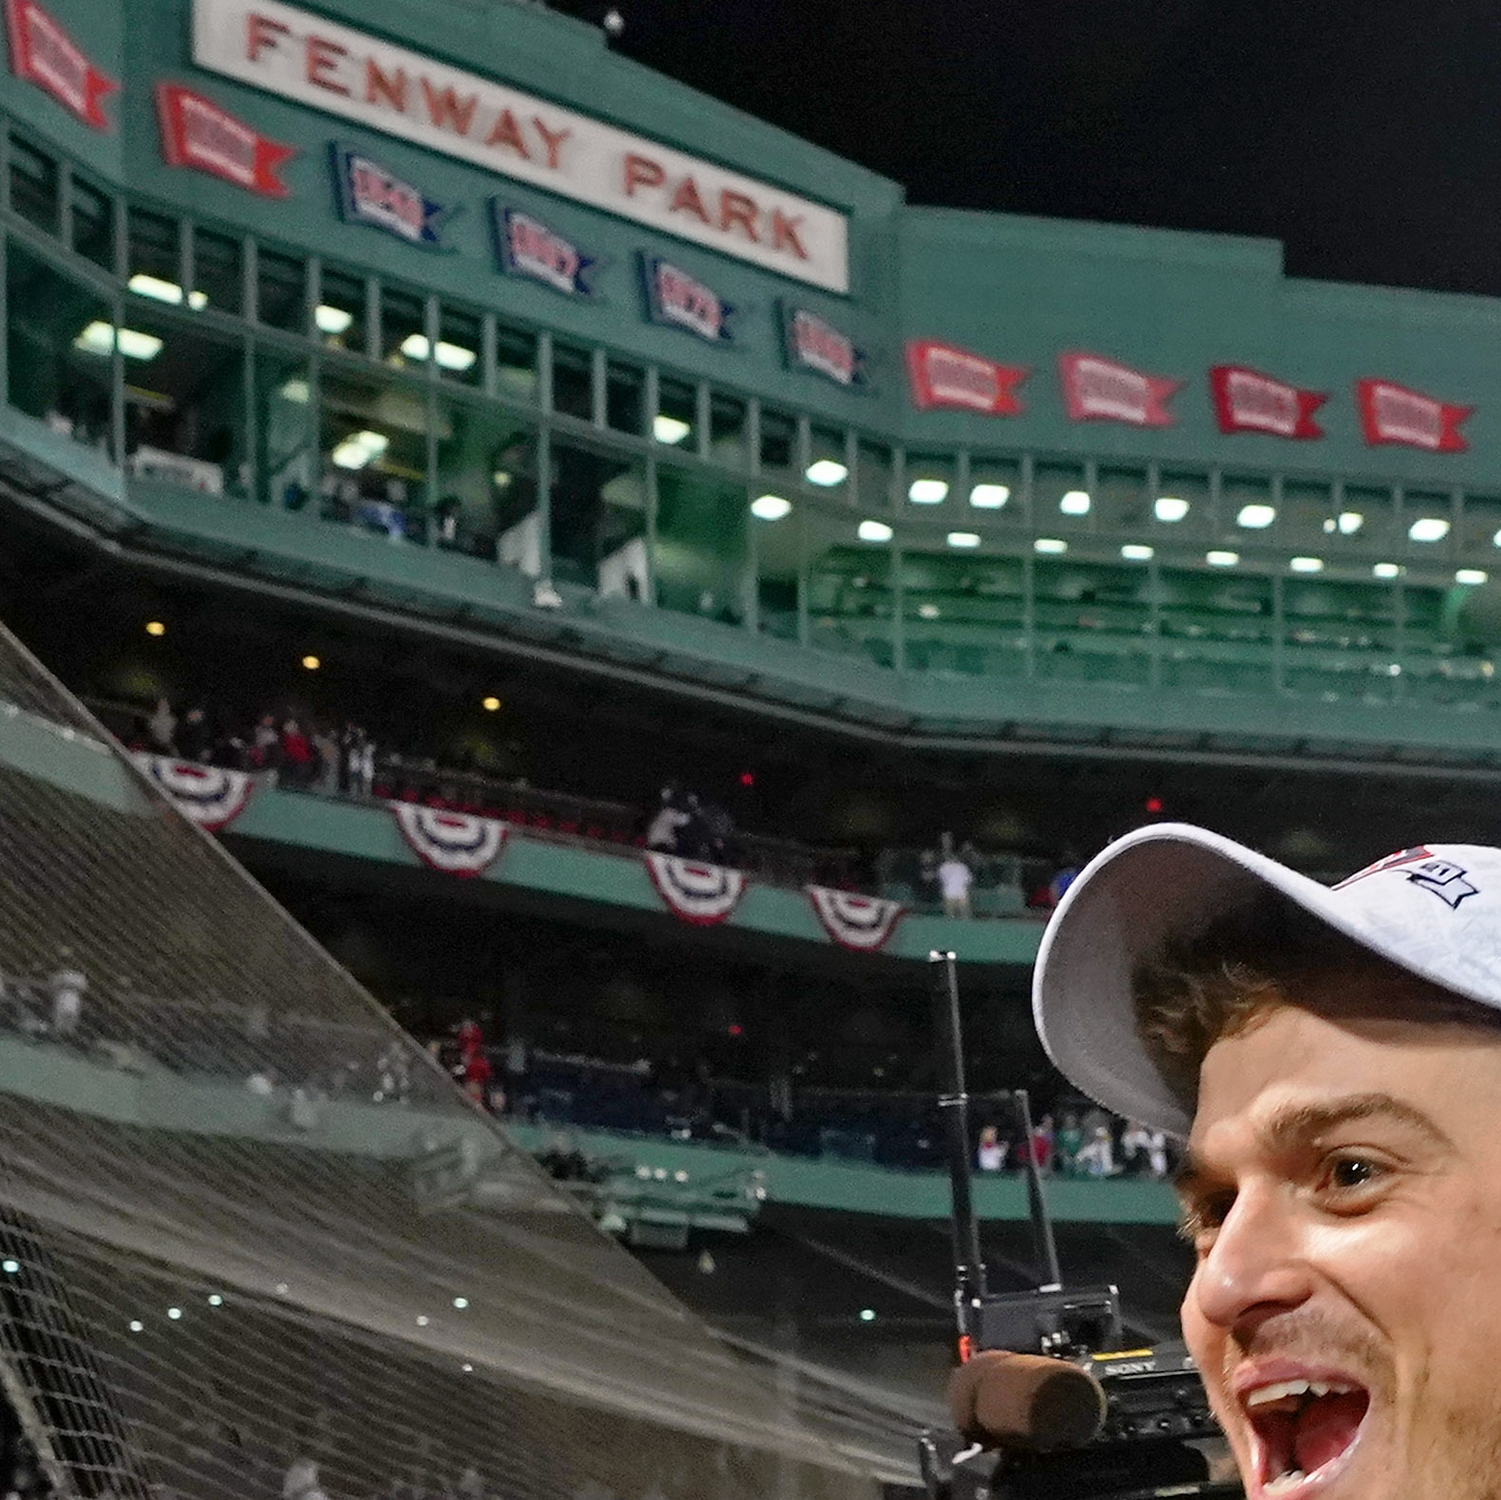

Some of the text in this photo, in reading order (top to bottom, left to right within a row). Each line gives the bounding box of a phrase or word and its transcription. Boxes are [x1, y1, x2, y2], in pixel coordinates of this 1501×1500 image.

[245, 13, 572, 172] FENWAY
[621, 152, 811, 262] PARK
[1104, 1360, 1157, 1377] SONY
